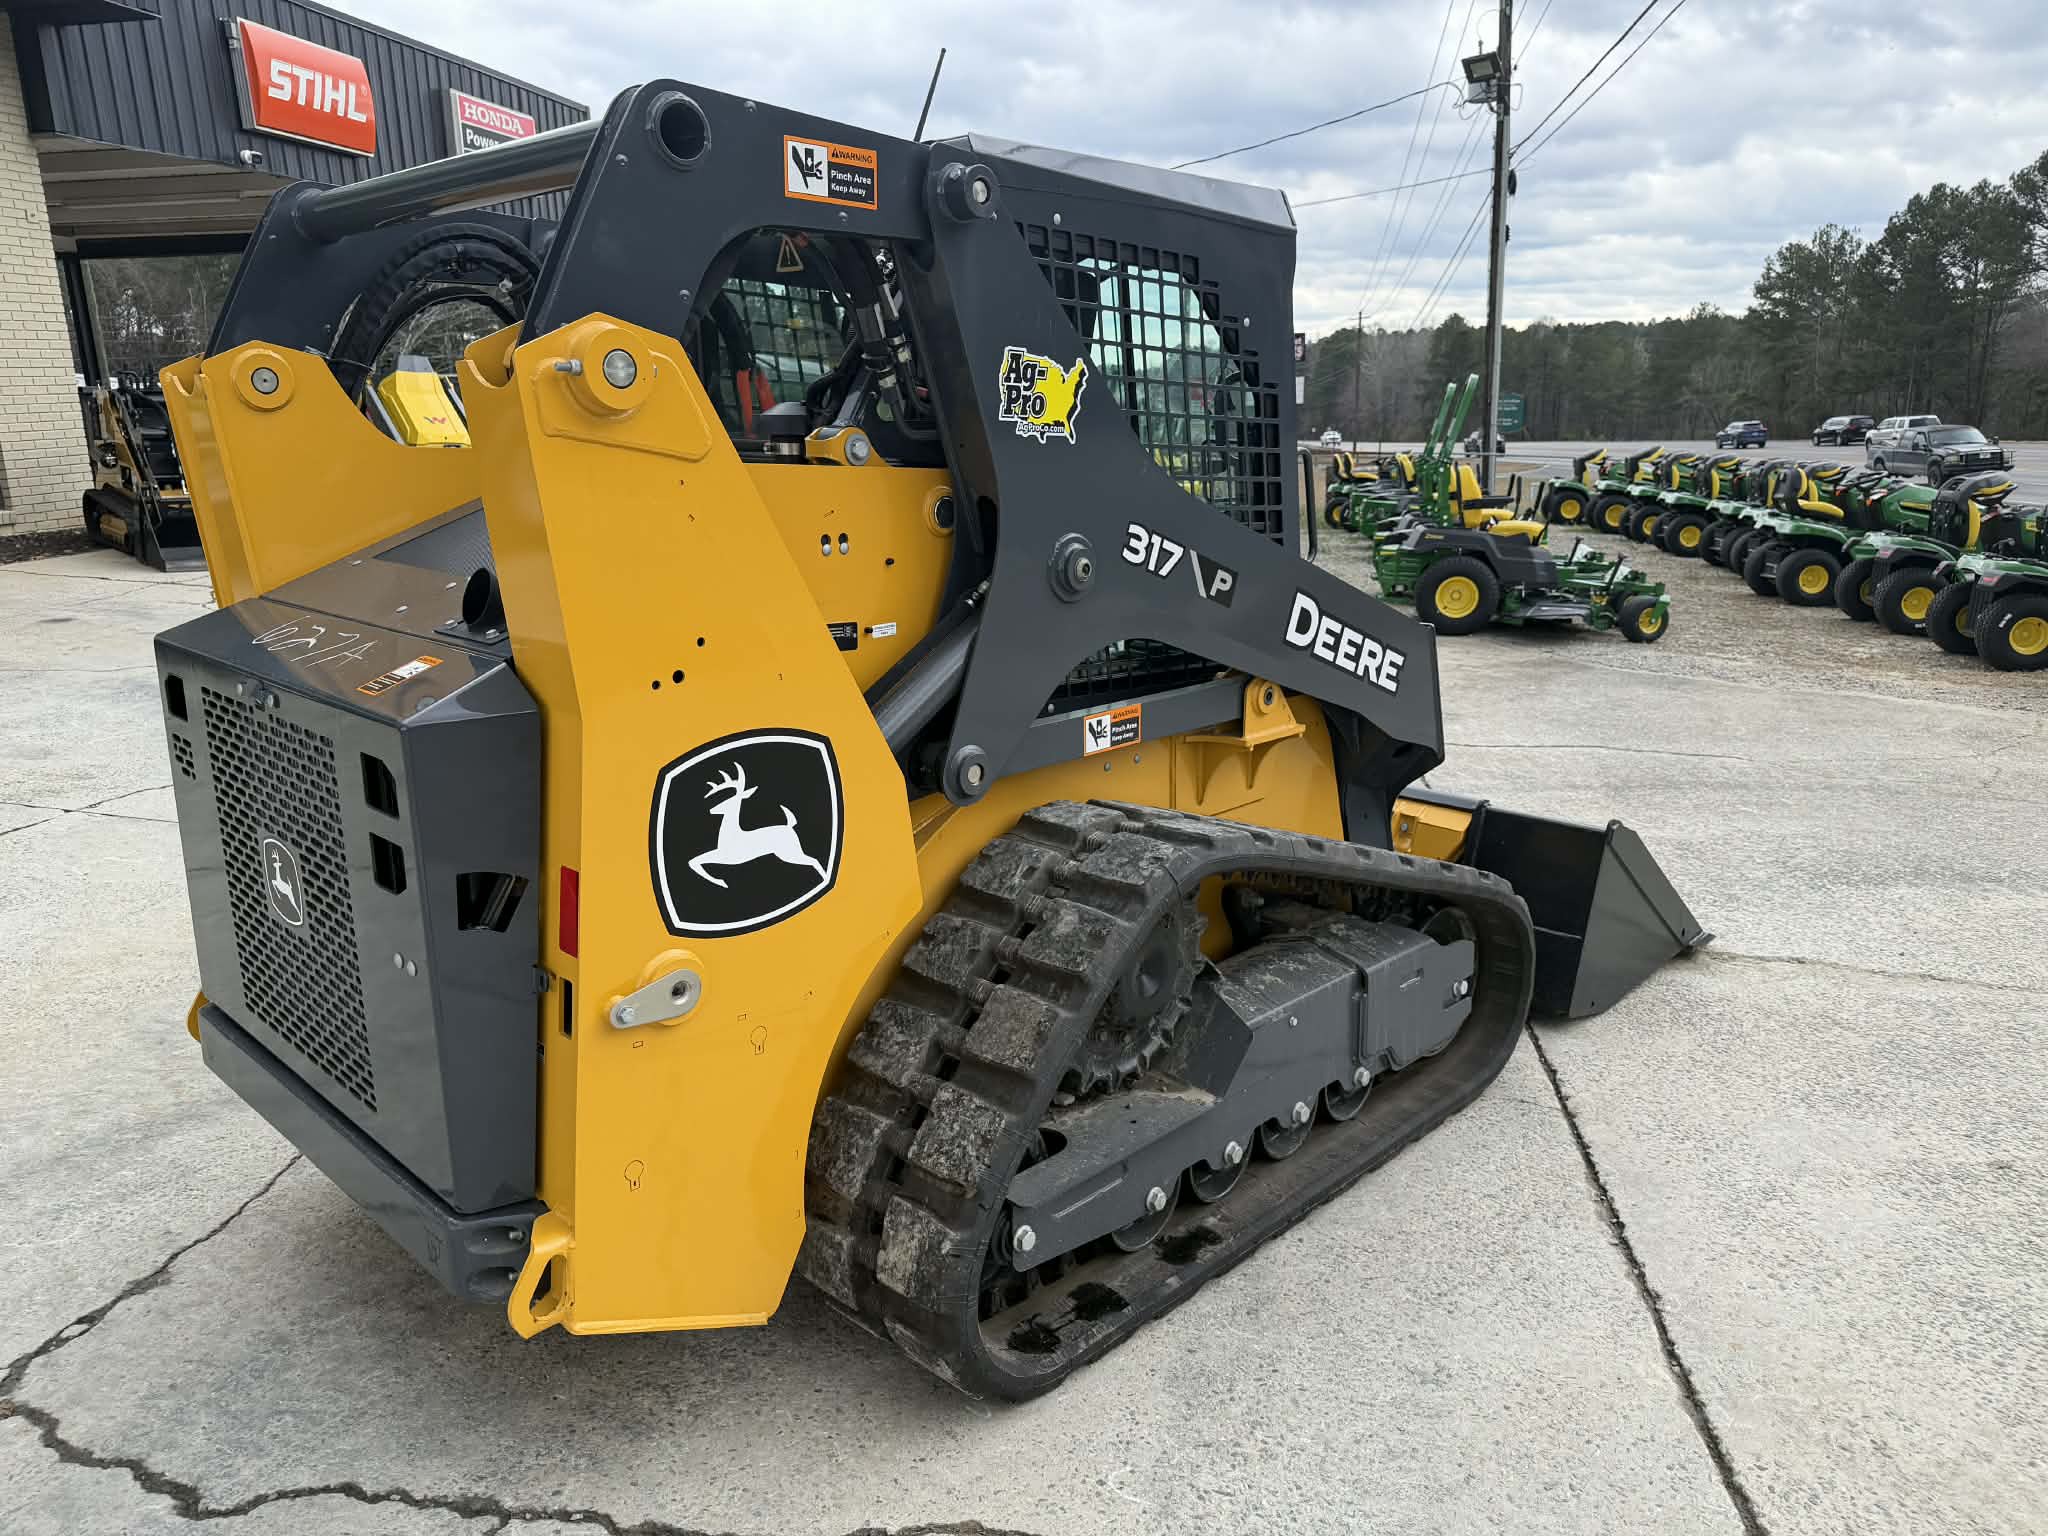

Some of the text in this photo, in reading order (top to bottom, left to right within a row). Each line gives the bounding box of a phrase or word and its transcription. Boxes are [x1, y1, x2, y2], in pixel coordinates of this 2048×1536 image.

[267, 58, 368, 123] STIHL
[463, 102, 525, 136] HONDA
[838, 150, 873, 164] WARNING
[831, 169, 872, 185] Pinch Area
[831, 183, 866, 197] Keep Away
[1003, 385, 1047, 418] Pro
[1017, 422, 1065, 434] AgProCo.com
[1122, 523, 1184, 577] 317
[1285, 592, 1405, 692] DEERE
